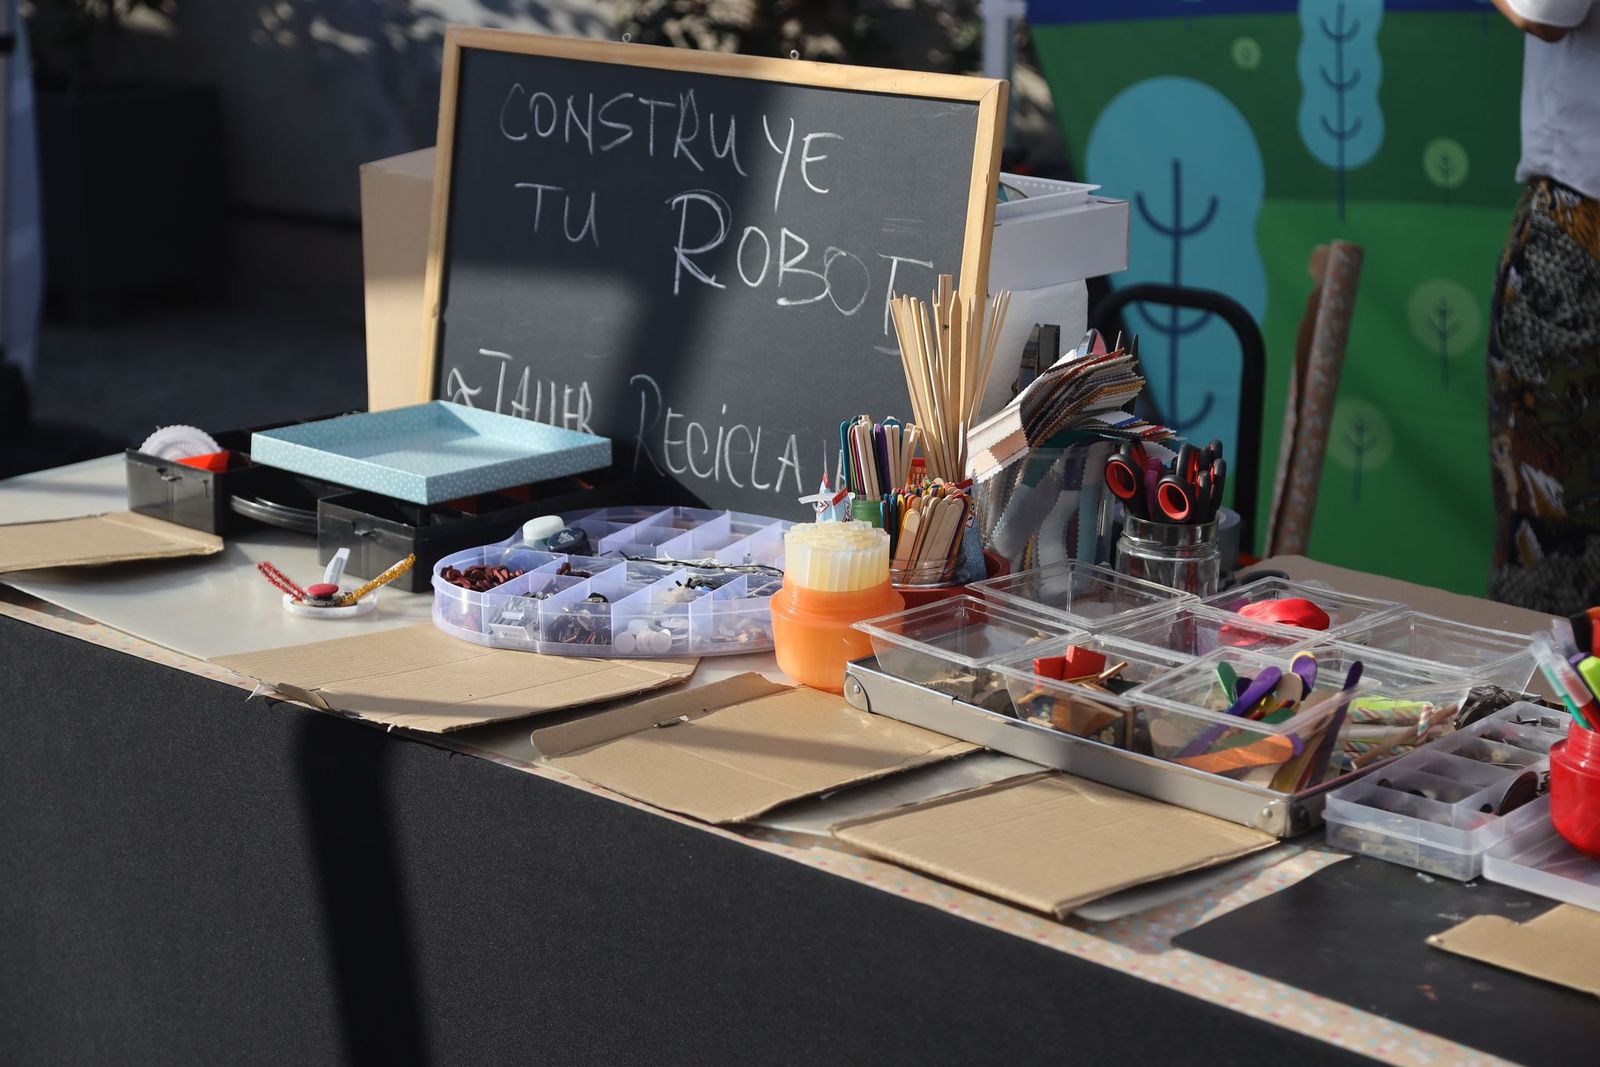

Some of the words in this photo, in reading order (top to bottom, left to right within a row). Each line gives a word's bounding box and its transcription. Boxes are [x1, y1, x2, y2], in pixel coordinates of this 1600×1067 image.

[500, 83, 844, 214] CONSTRUYE
[514, 182, 600, 247] TU
[664, 188, 934, 336] ROBOT
